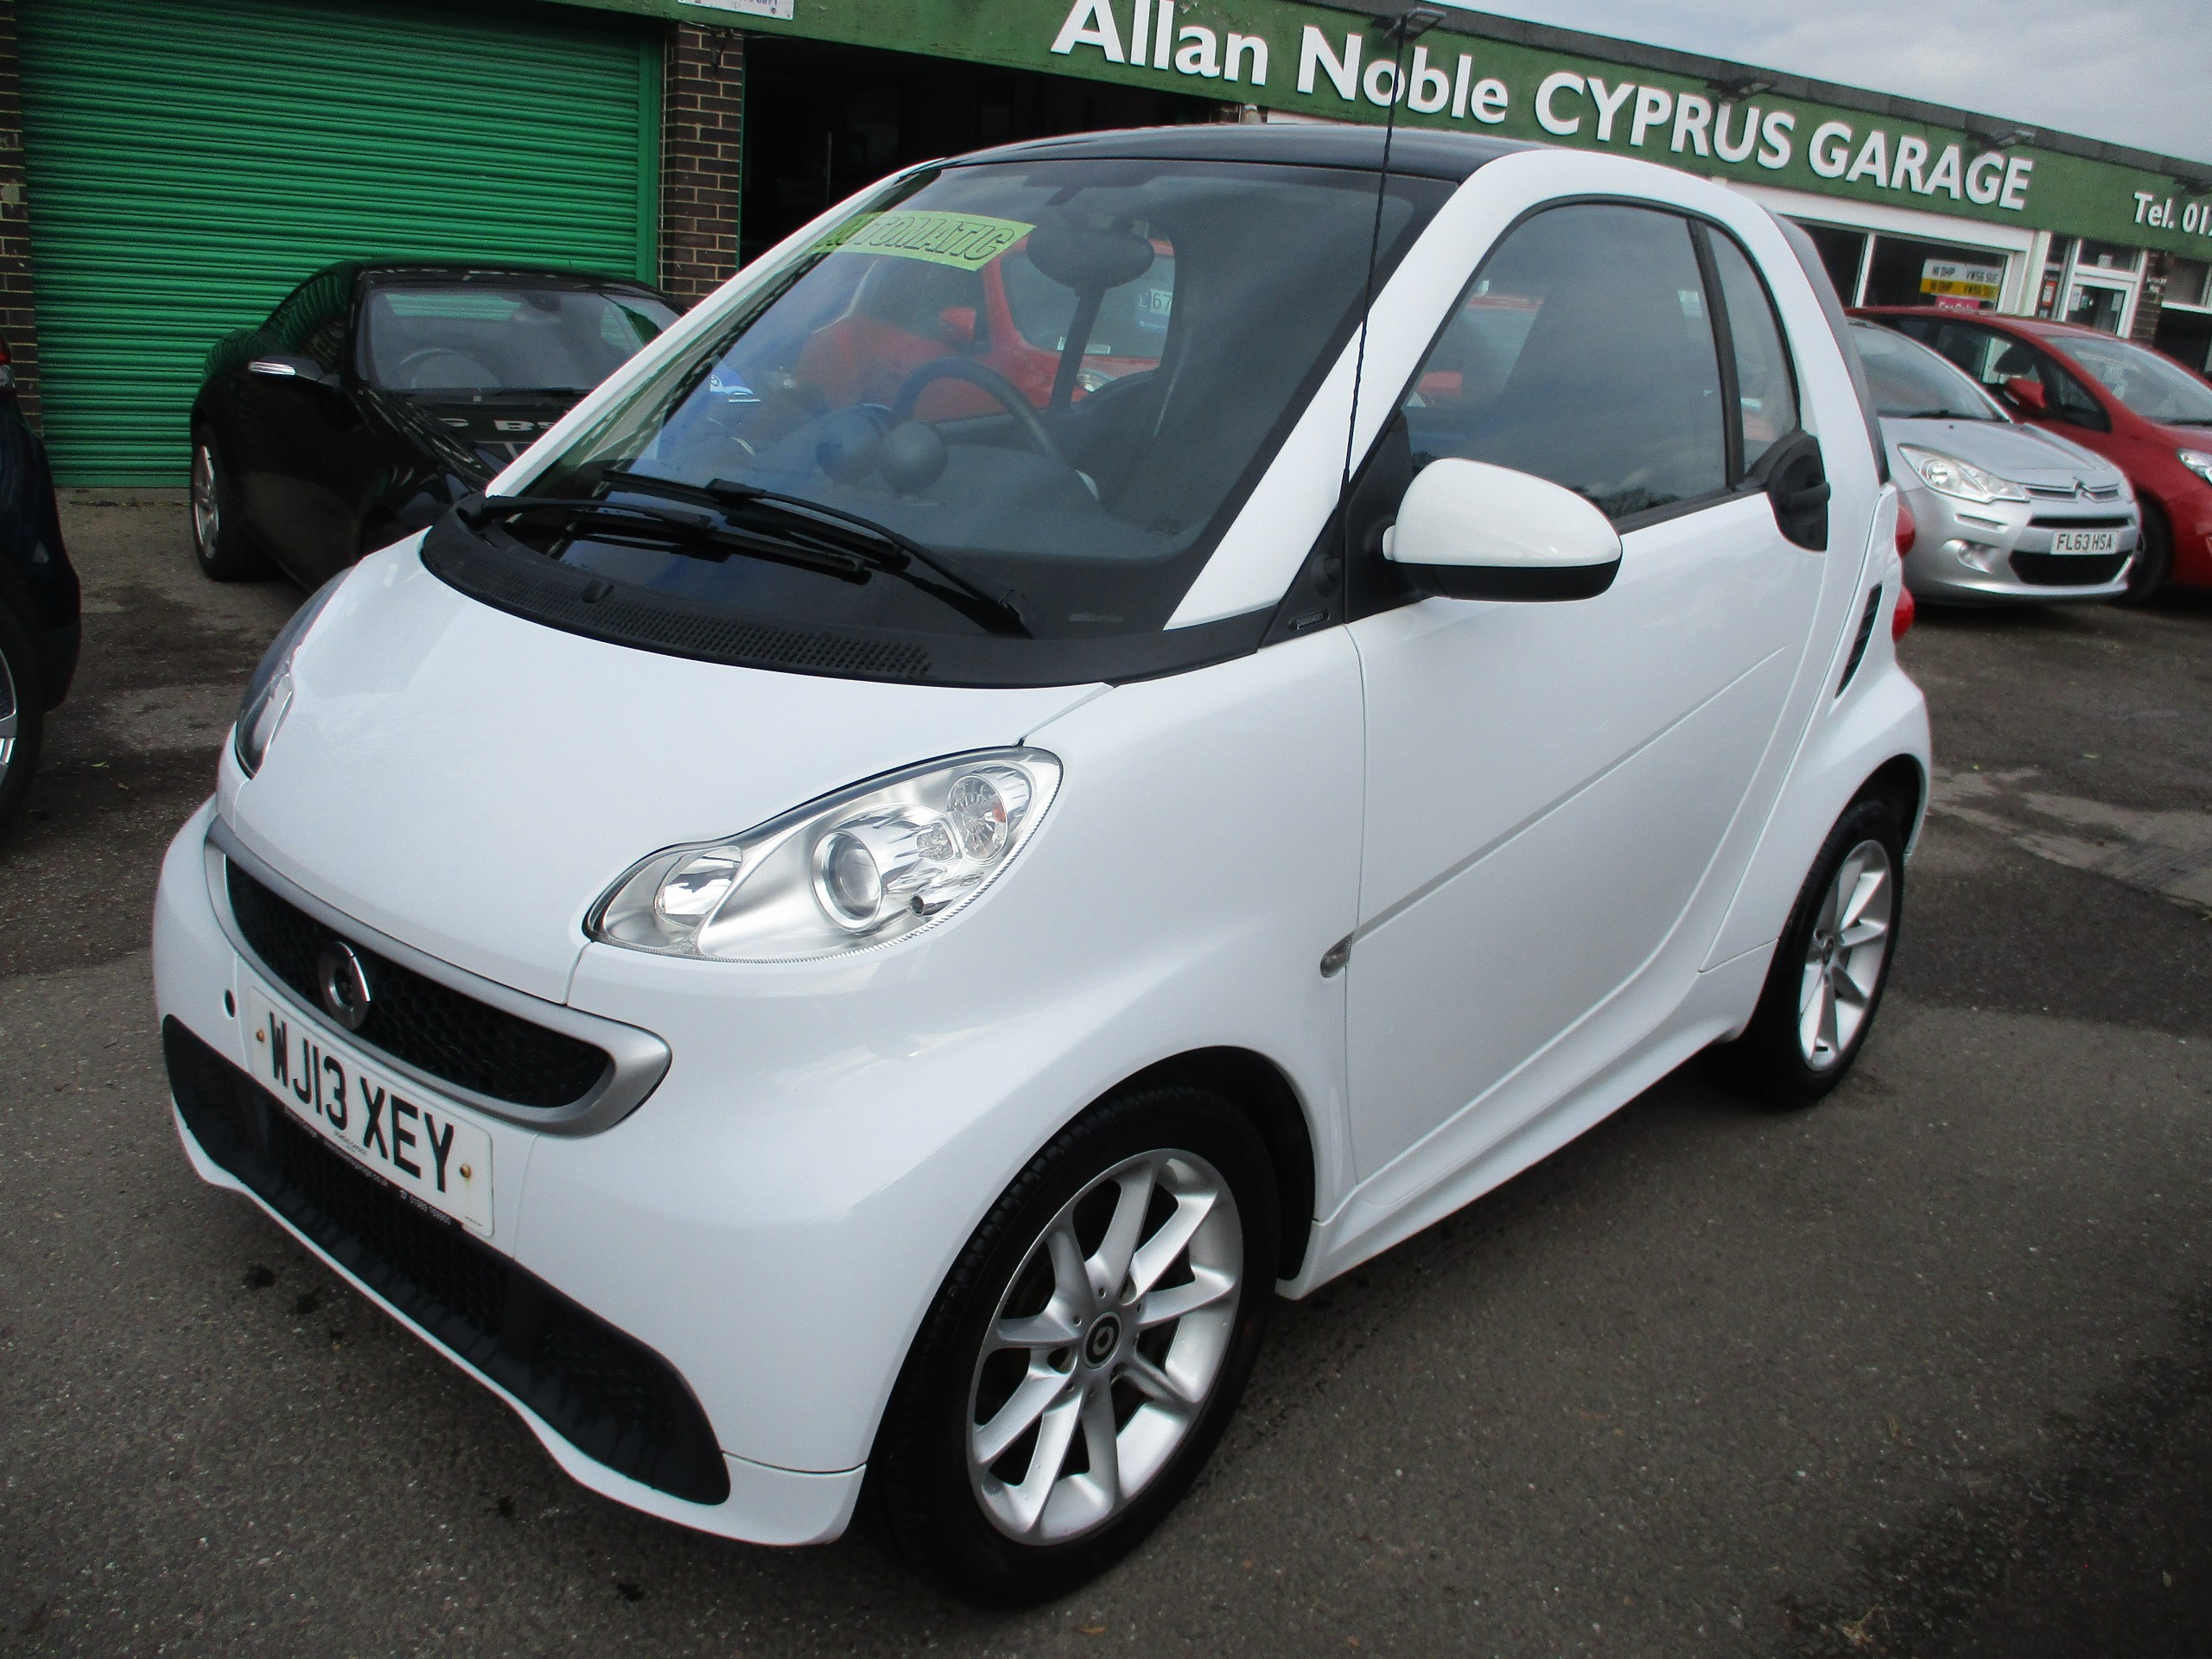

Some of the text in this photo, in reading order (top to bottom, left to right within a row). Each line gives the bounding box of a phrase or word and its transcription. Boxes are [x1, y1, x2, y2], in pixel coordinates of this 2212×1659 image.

[1050, 0, 2034, 212] Allan Noble CYPRUS GARAGE
[2134, 191, 2212, 236] Tel. 01
[2056, 533, 2112, 551] FL63 HSA
[1297, 612, 1324, 630] passion
[270, 1011, 348, 1131] WJ13
[359, 1076, 454, 1194] XEY
